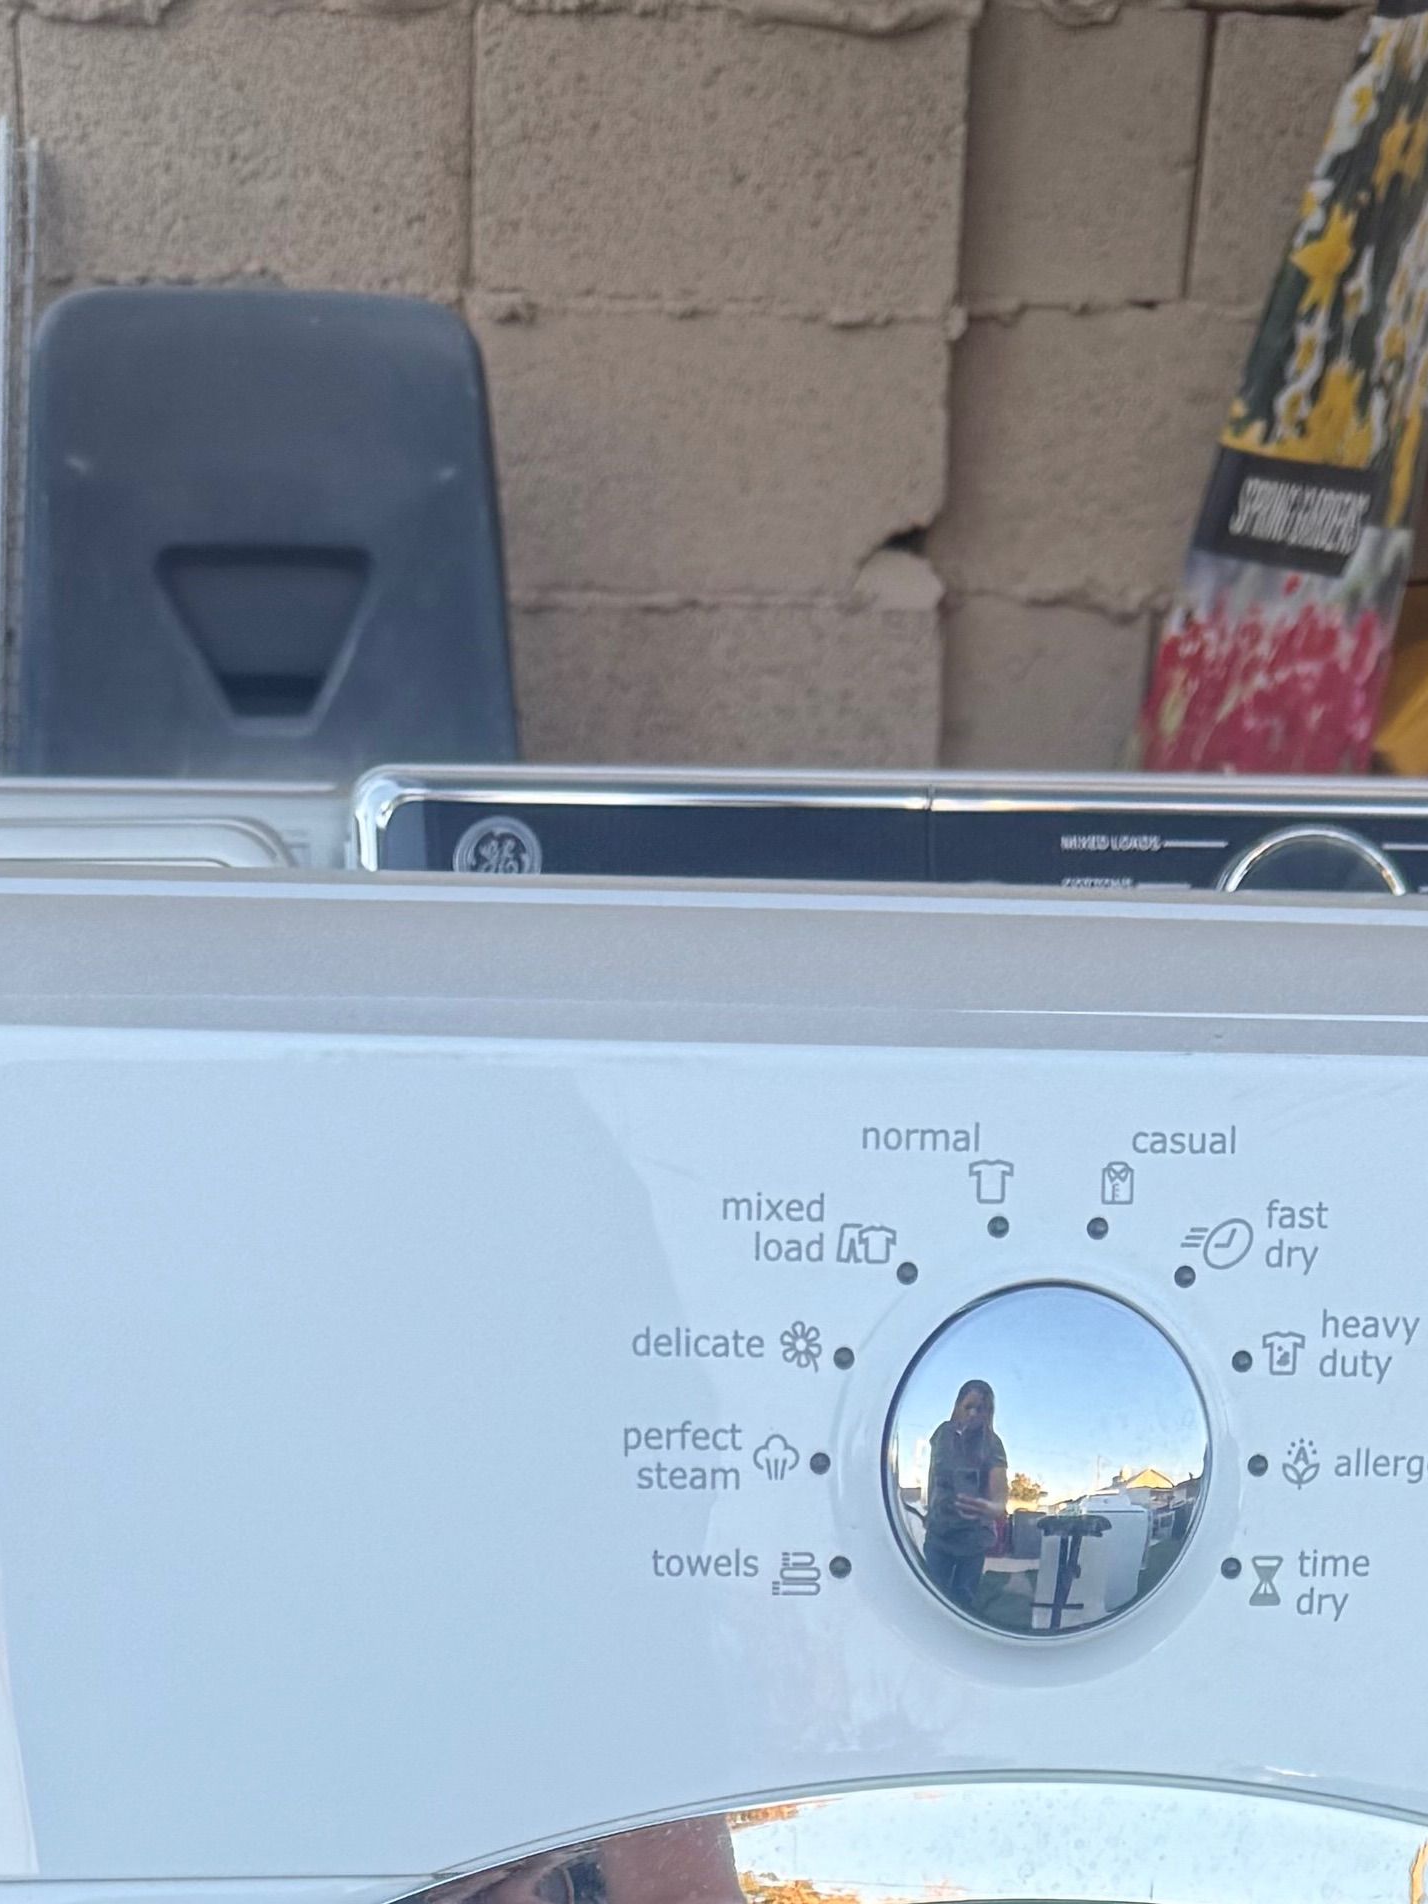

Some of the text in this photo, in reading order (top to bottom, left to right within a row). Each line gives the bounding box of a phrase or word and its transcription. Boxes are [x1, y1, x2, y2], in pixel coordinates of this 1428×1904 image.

[862, 1123, 980, 1153] normal
[1132, 1125, 1236, 1156] casual
[722, 1192, 825, 1223] mixed
[1266, 1199, 1328, 1232] fast
[754, 1232, 824, 1264] load
[1266, 1239, 1319, 1275] dry
[632, 1326, 764, 1360] delicate
[1321, 1310, 1420, 1346] heavy
[1320, 1349, 1392, 1384] duty
[623, 1421, 742, 1457] perfect
[637, 1464, 741, 1491] steam
[652, 1549, 759, 1579] towels
[1298, 1549, 1370, 1578] time
[1295, 1588, 1349, 1621] dry
